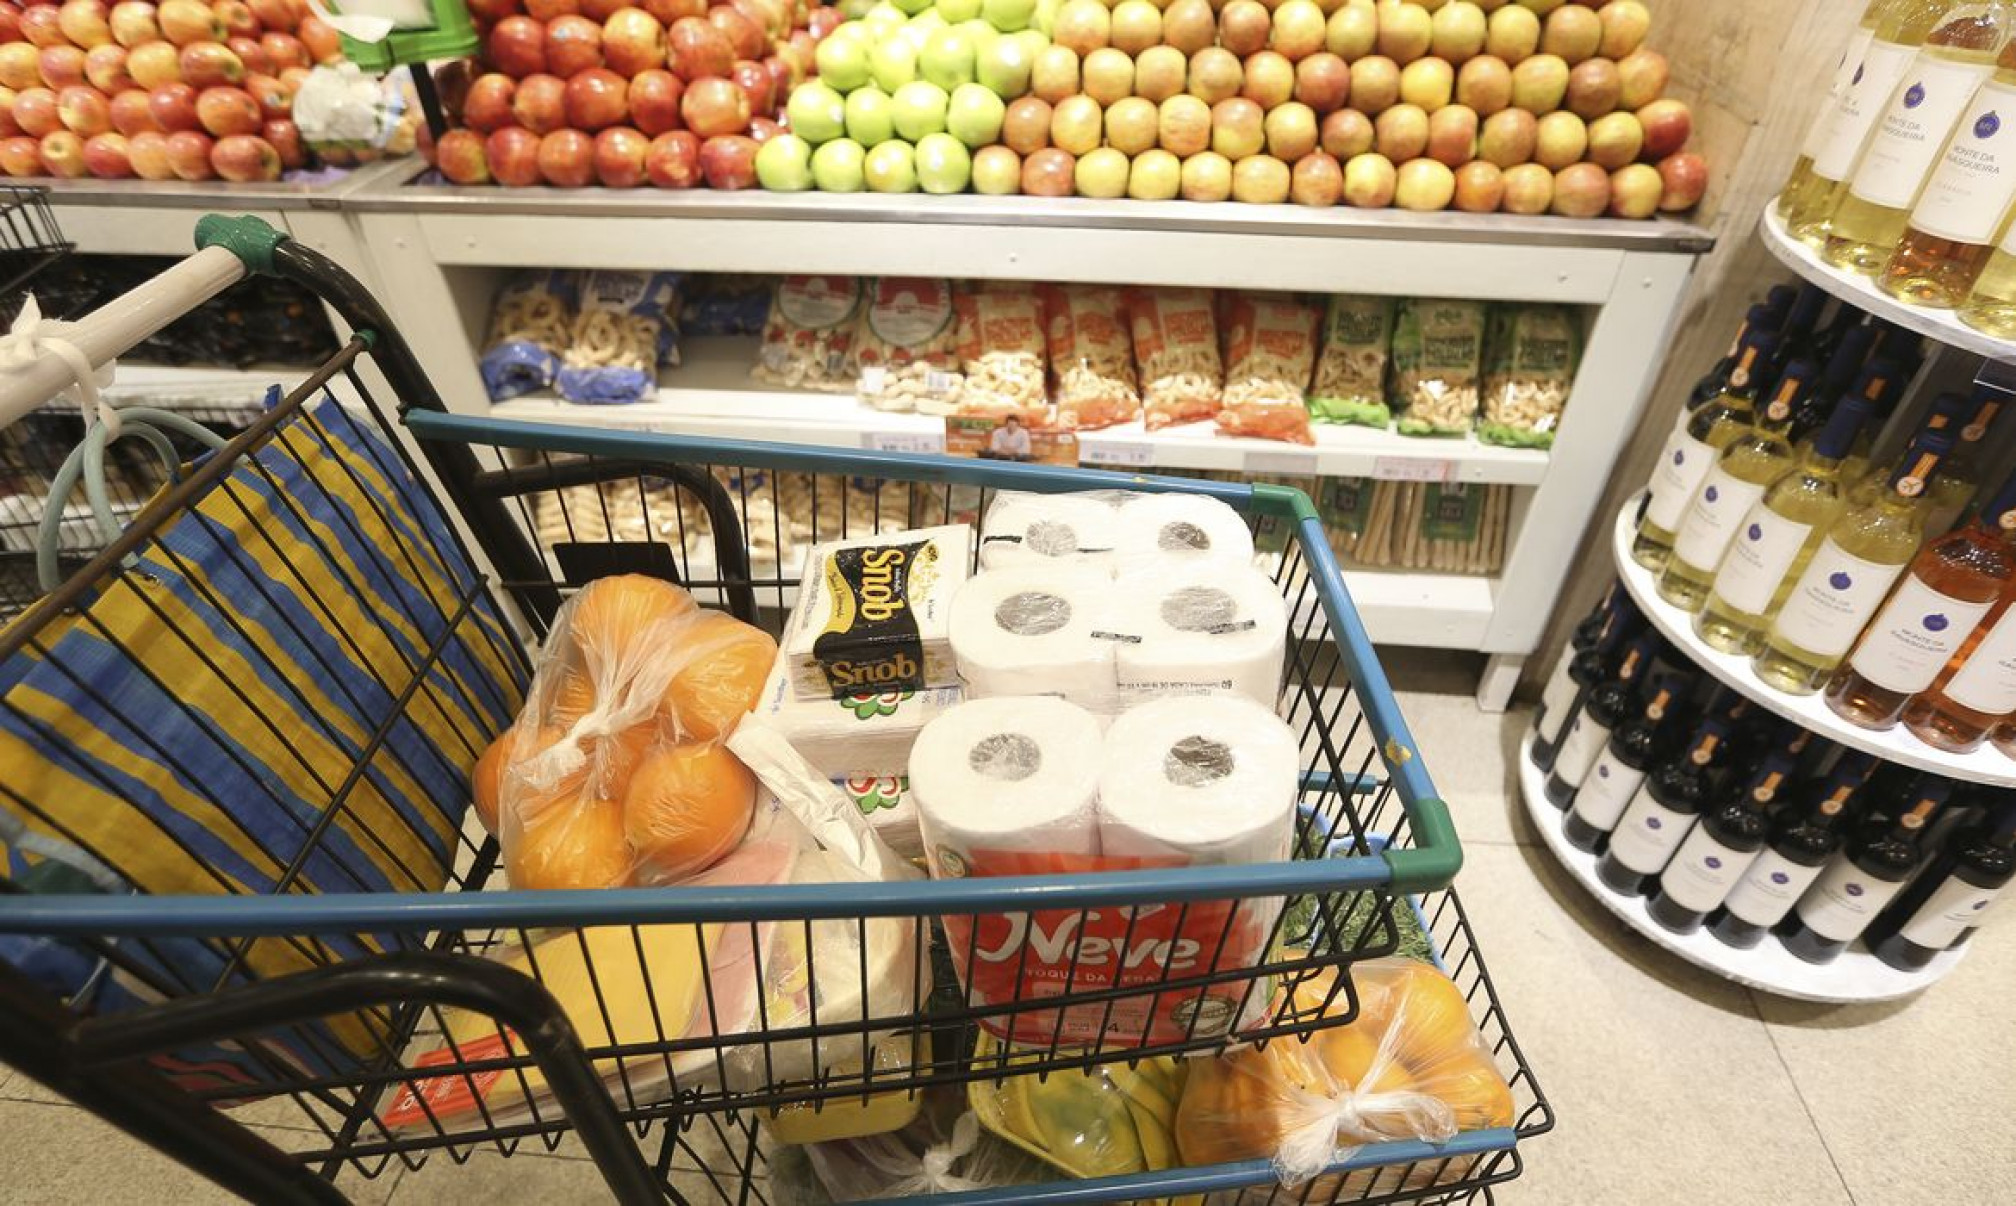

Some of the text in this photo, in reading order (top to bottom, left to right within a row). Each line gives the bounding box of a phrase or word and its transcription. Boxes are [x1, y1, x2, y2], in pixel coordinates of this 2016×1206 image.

[861, 550, 906, 620] Snob
[830, 653, 917, 687] Snob
[976, 911, 1201, 970] Neve
[1086, 972, 1107, 983] DA
